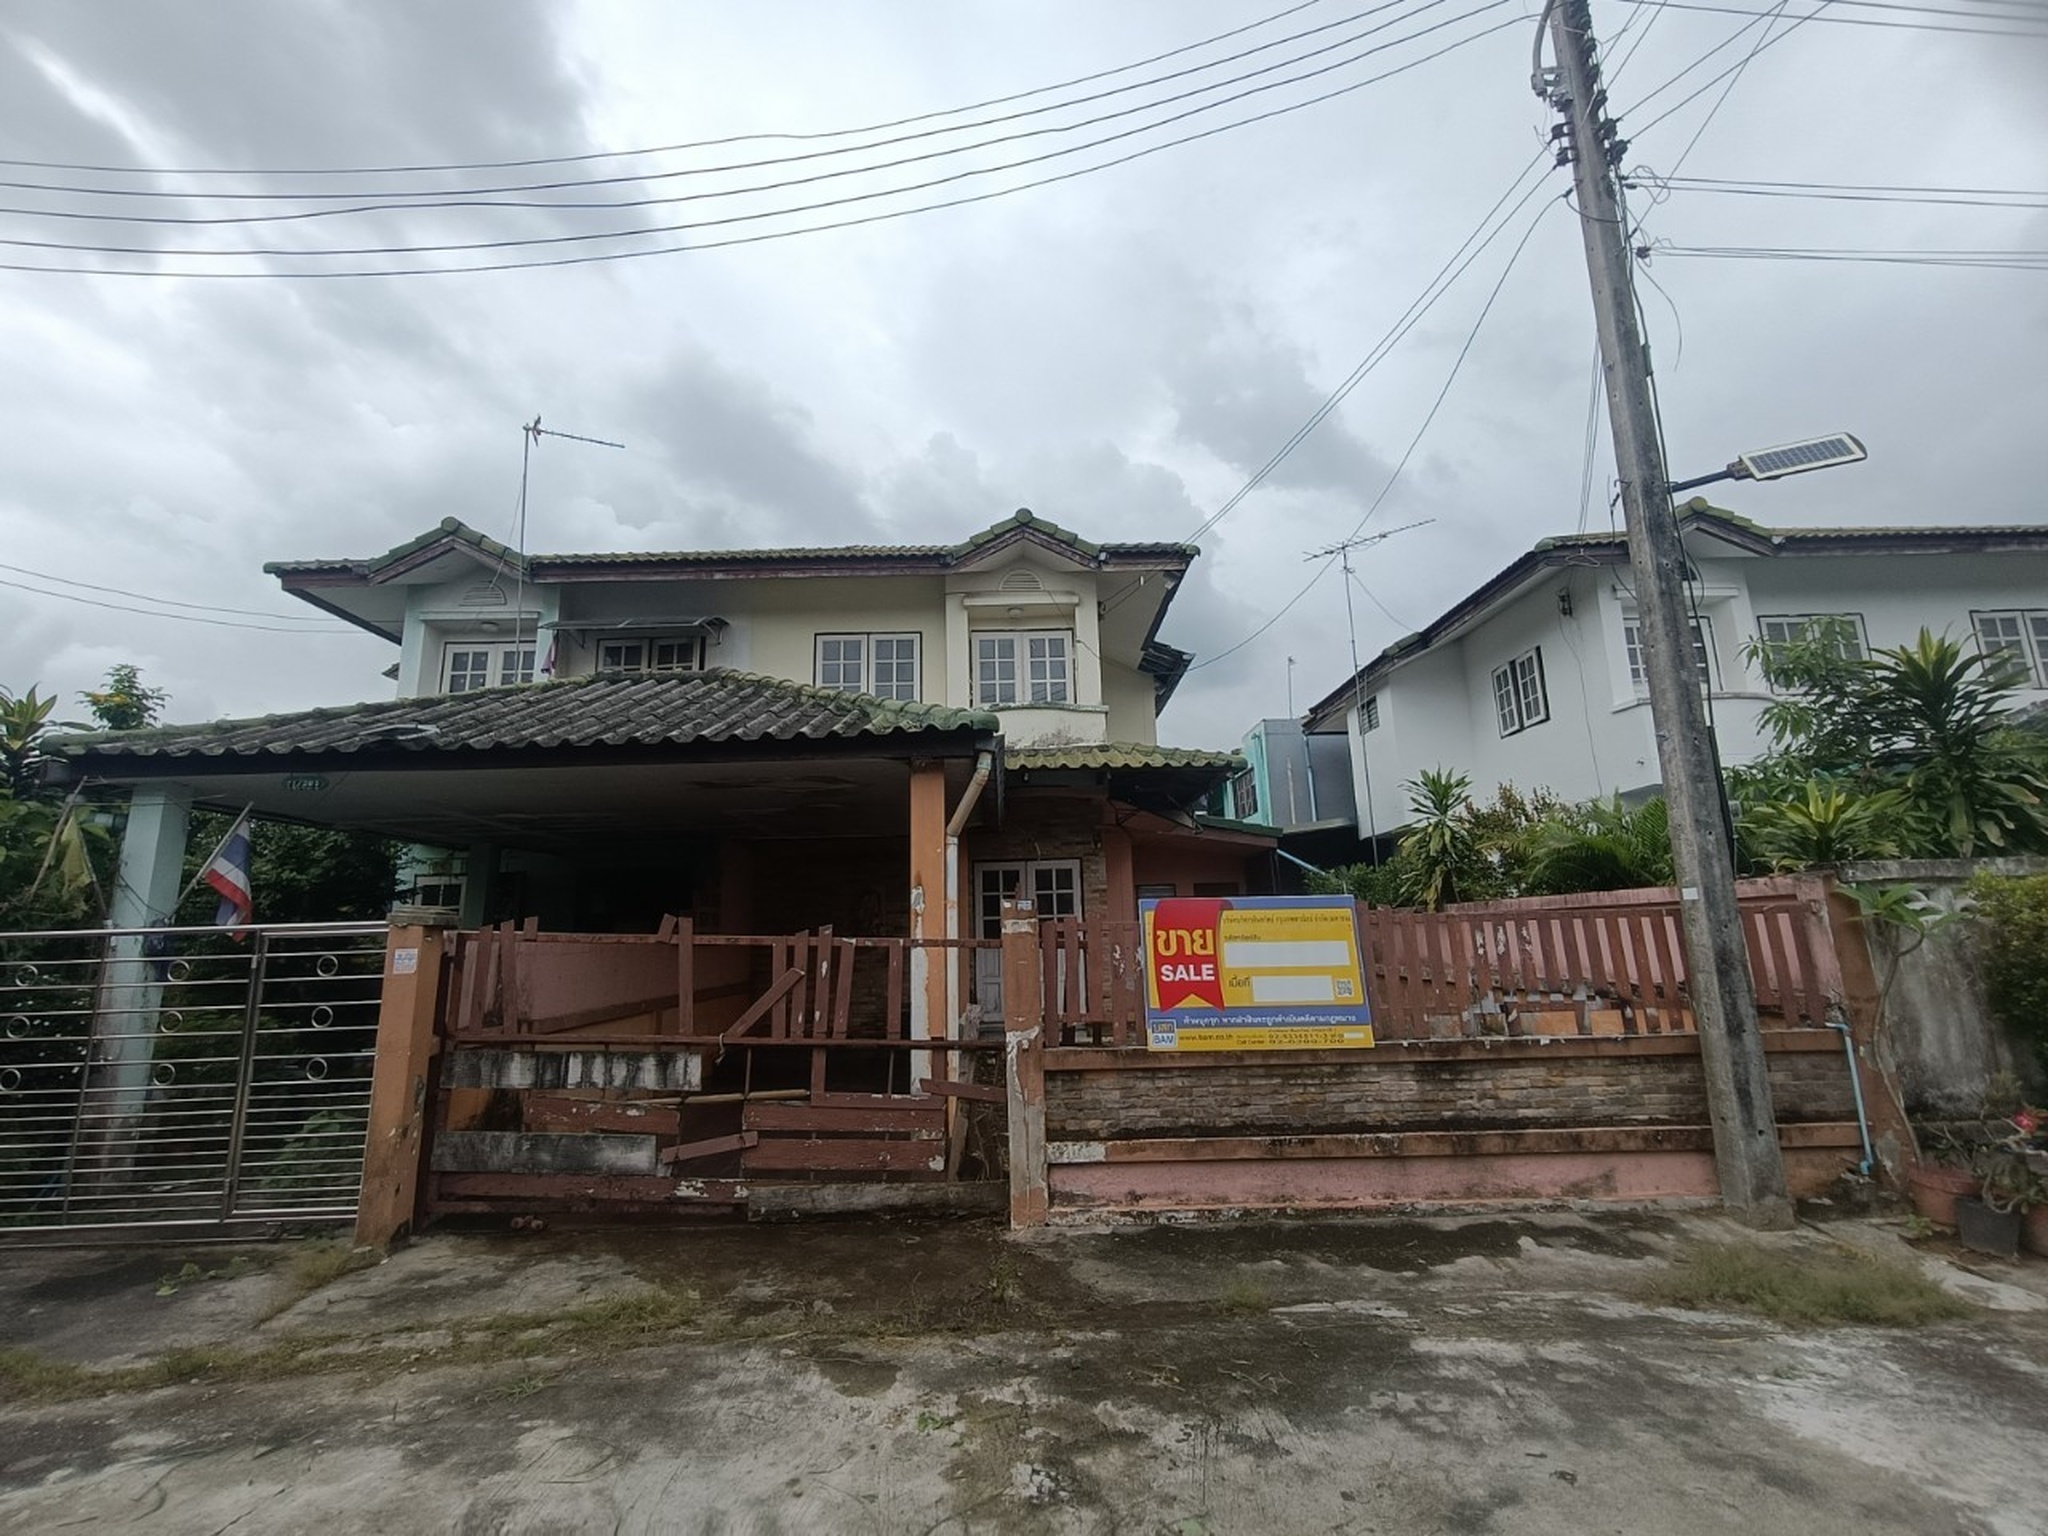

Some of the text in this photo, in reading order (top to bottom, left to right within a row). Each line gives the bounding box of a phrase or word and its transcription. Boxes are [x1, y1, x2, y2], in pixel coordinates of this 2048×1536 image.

[1156, 929, 1215, 957] ขาย
[1161, 964, 1215, 982] SALE
[1153, 1034, 1174, 1045] BAM
